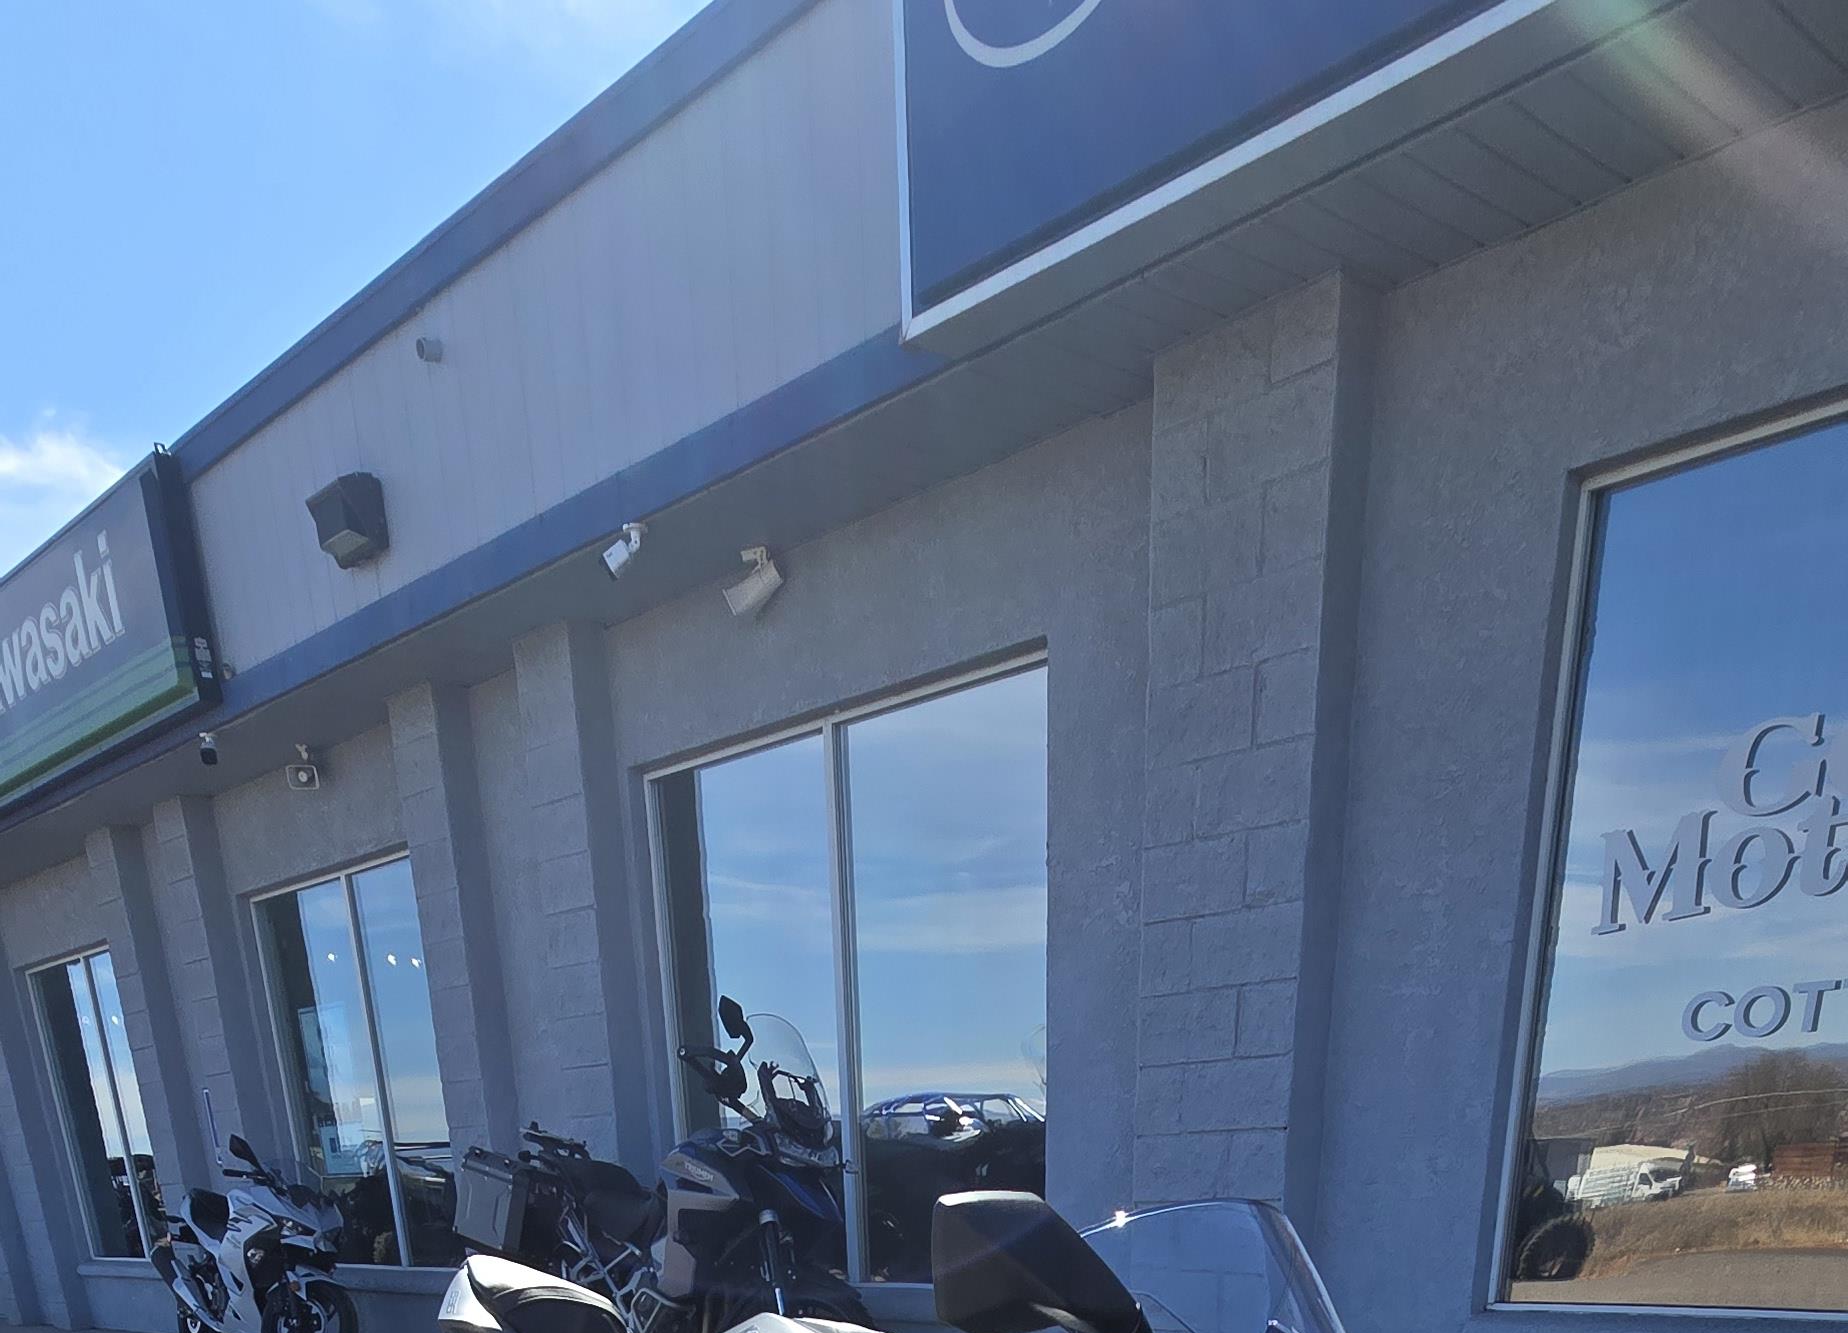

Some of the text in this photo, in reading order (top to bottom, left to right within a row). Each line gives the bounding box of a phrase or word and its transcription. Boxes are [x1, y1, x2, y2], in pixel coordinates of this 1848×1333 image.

[0, 529, 125, 713] wasaki
[1714, 713, 1848, 818] C
[1681, 978, 1848, 1042] COT
